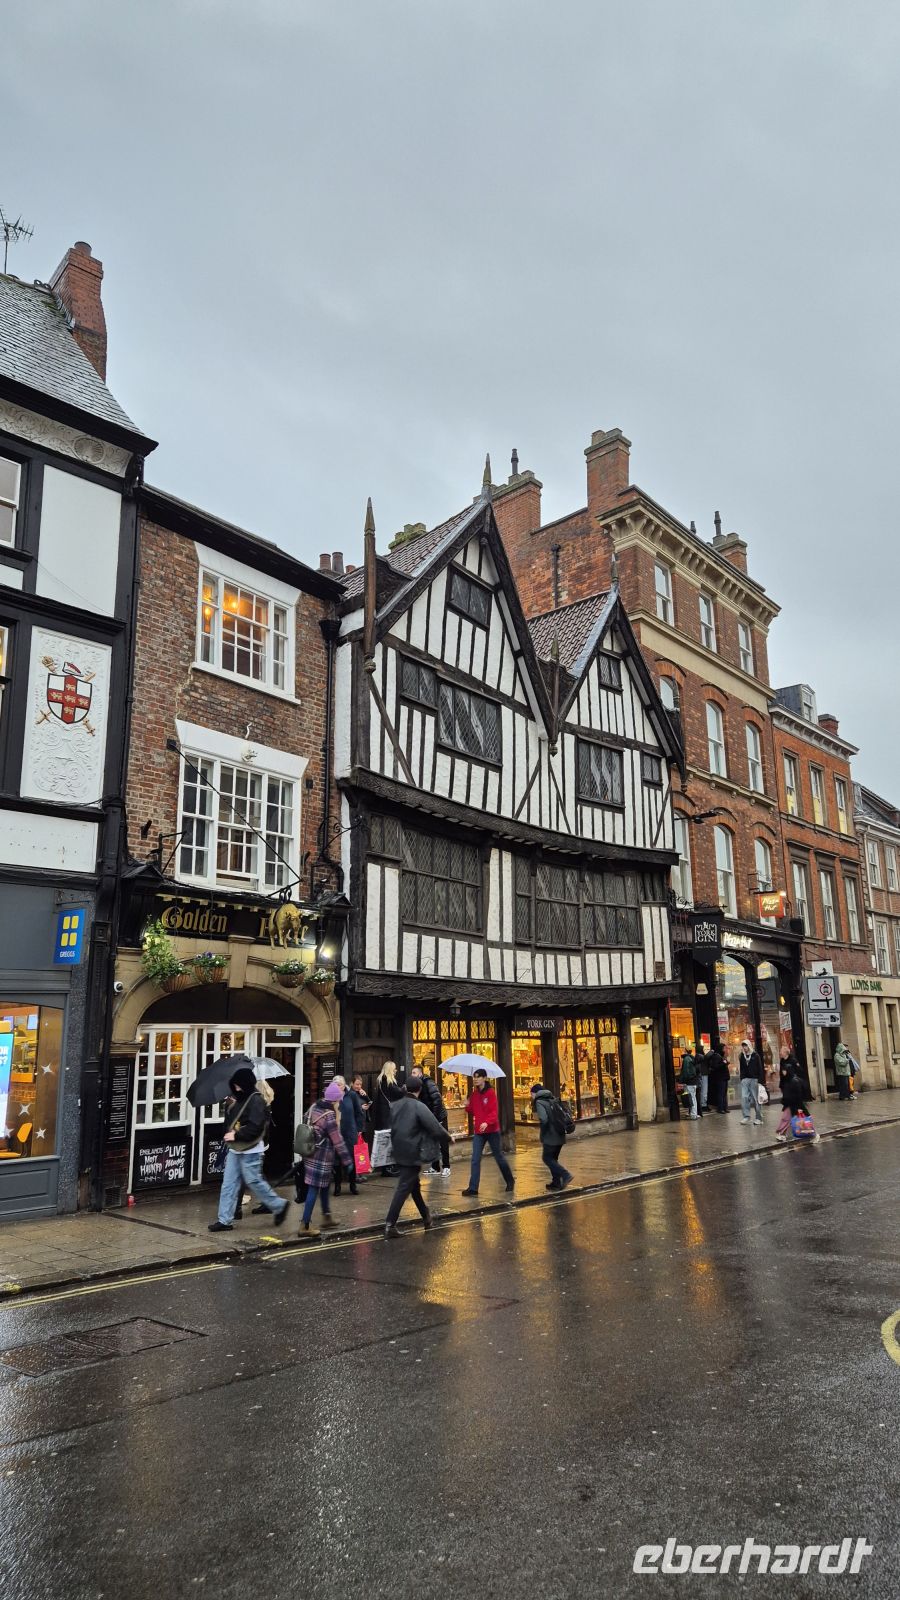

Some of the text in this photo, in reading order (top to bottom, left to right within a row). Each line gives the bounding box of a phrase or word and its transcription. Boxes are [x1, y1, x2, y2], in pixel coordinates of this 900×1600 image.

[161, 906, 228, 933] Golden
[850, 978, 883, 992] LLOYDS BANK
[526, 1019, 556, 1029] YORK GIN
[169, 1144, 186, 1157] LIVE
[168, 1167, 185, 1180] 9PM
